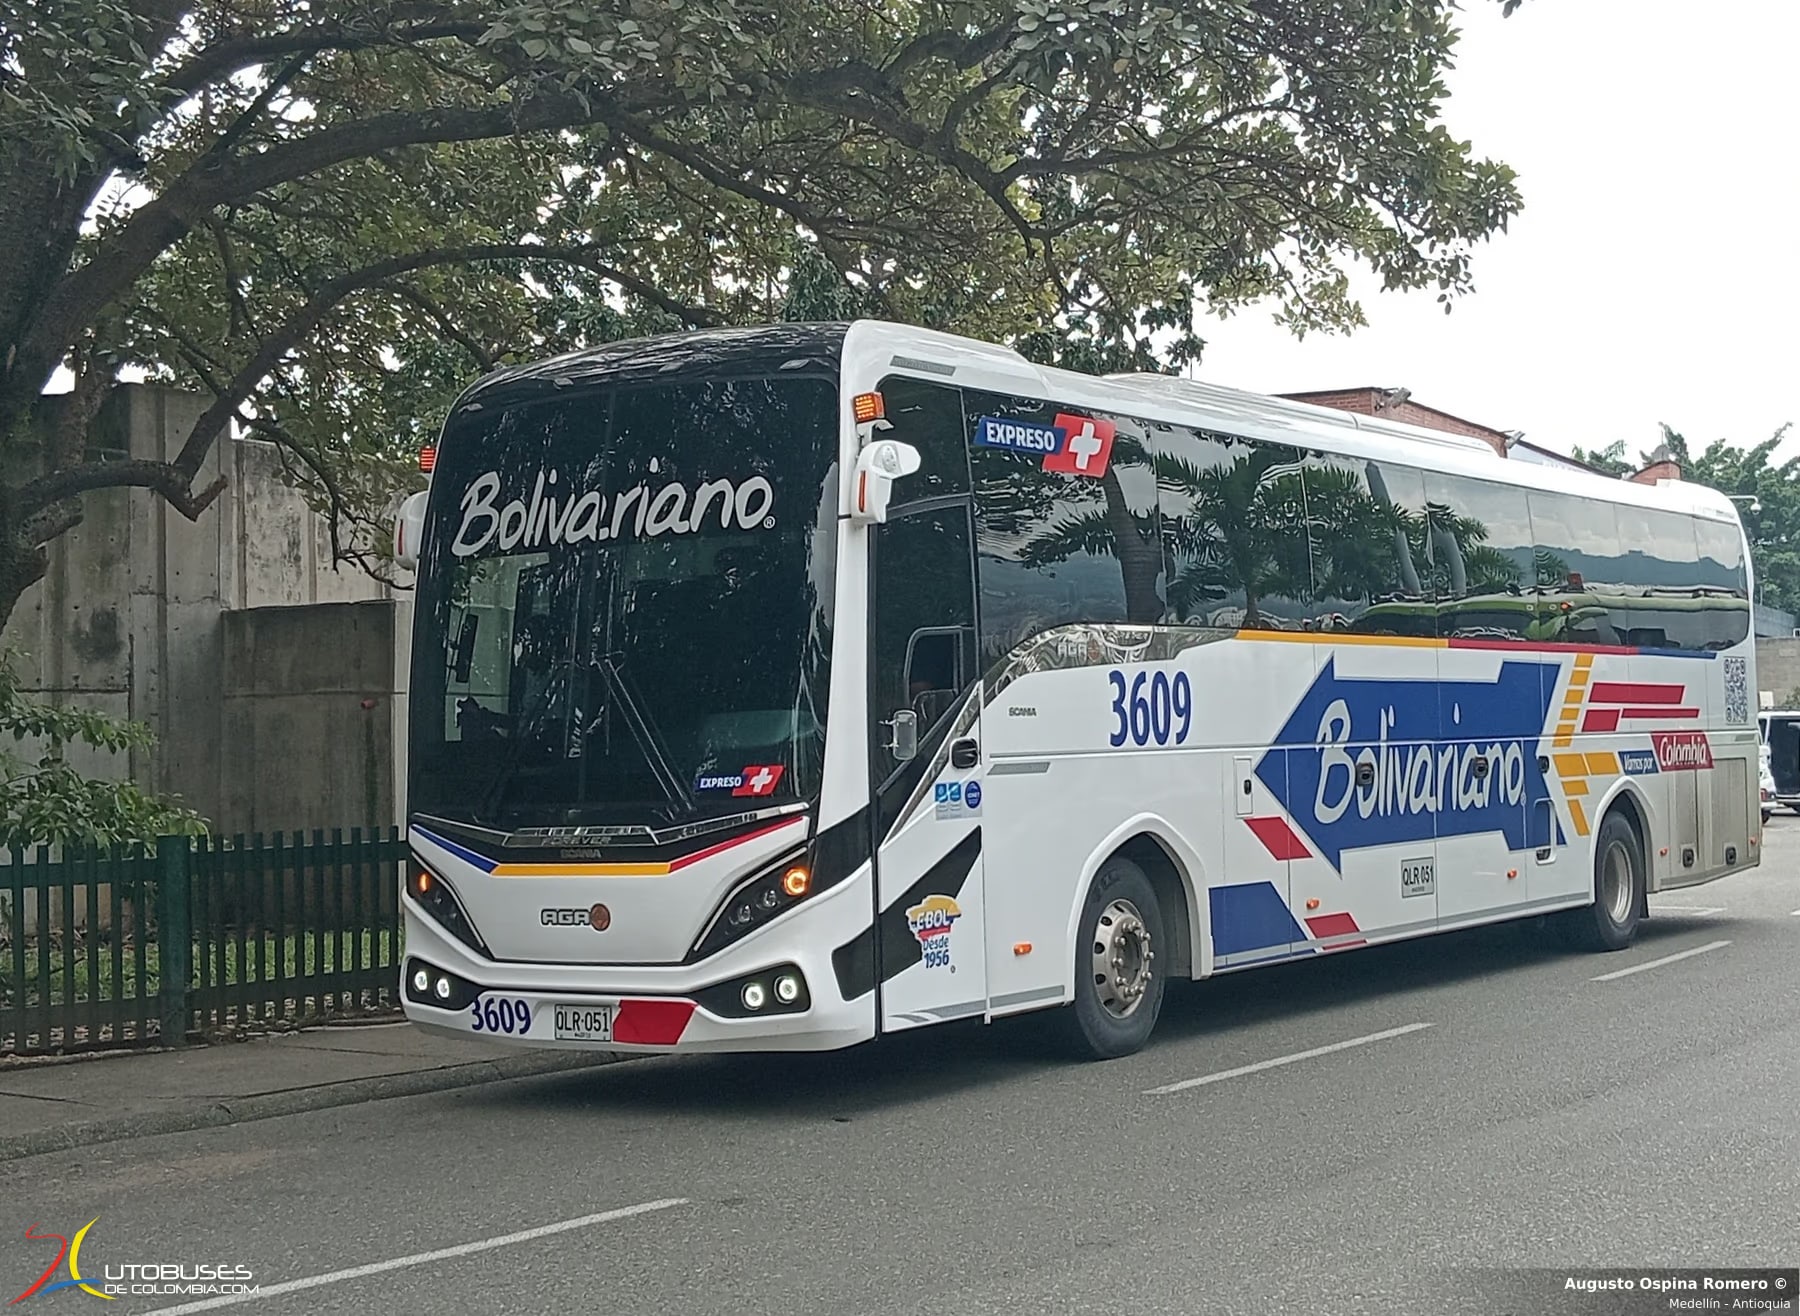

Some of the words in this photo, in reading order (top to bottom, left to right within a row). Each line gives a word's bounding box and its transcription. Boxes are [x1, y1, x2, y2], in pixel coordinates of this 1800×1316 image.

[985, 421, 1056, 452] EXPRESO
[1008, 706, 1037, 717] SCANIA
[1108, 669, 1192, 747] 3609
[1660, 735, 1707, 767] Colombia
[700, 776, 742, 789] EXPRESO
[541, 909, 591, 926] AGA
[923, 935, 949, 951] Desde
[924, 949, 950, 969] 1956
[471, 997, 531, 1035] 3609
